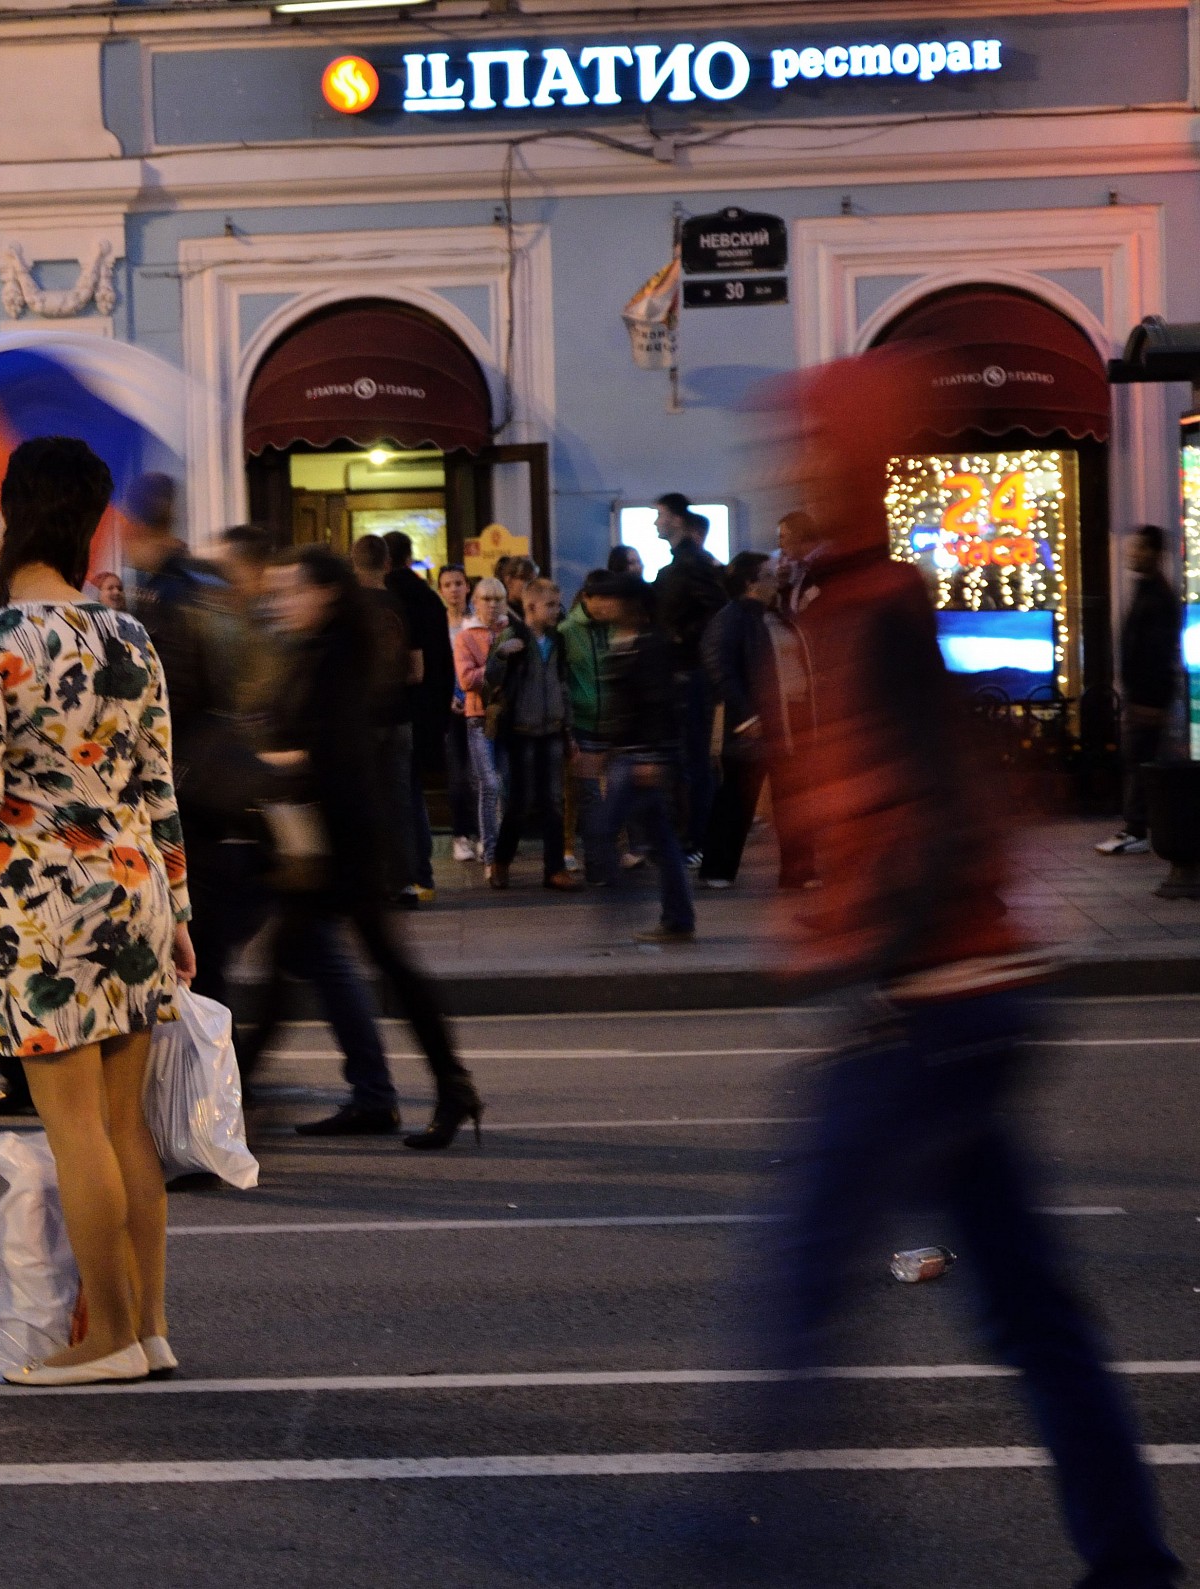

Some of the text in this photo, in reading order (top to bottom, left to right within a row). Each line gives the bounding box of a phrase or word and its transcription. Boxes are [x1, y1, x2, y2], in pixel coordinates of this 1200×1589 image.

[770, 39, 1002, 87] ресторан
[700, 228, 769, 249] НЕВСКИЙ
[725, 281, 745, 300] 30
[941, 470, 1039, 537] 24
